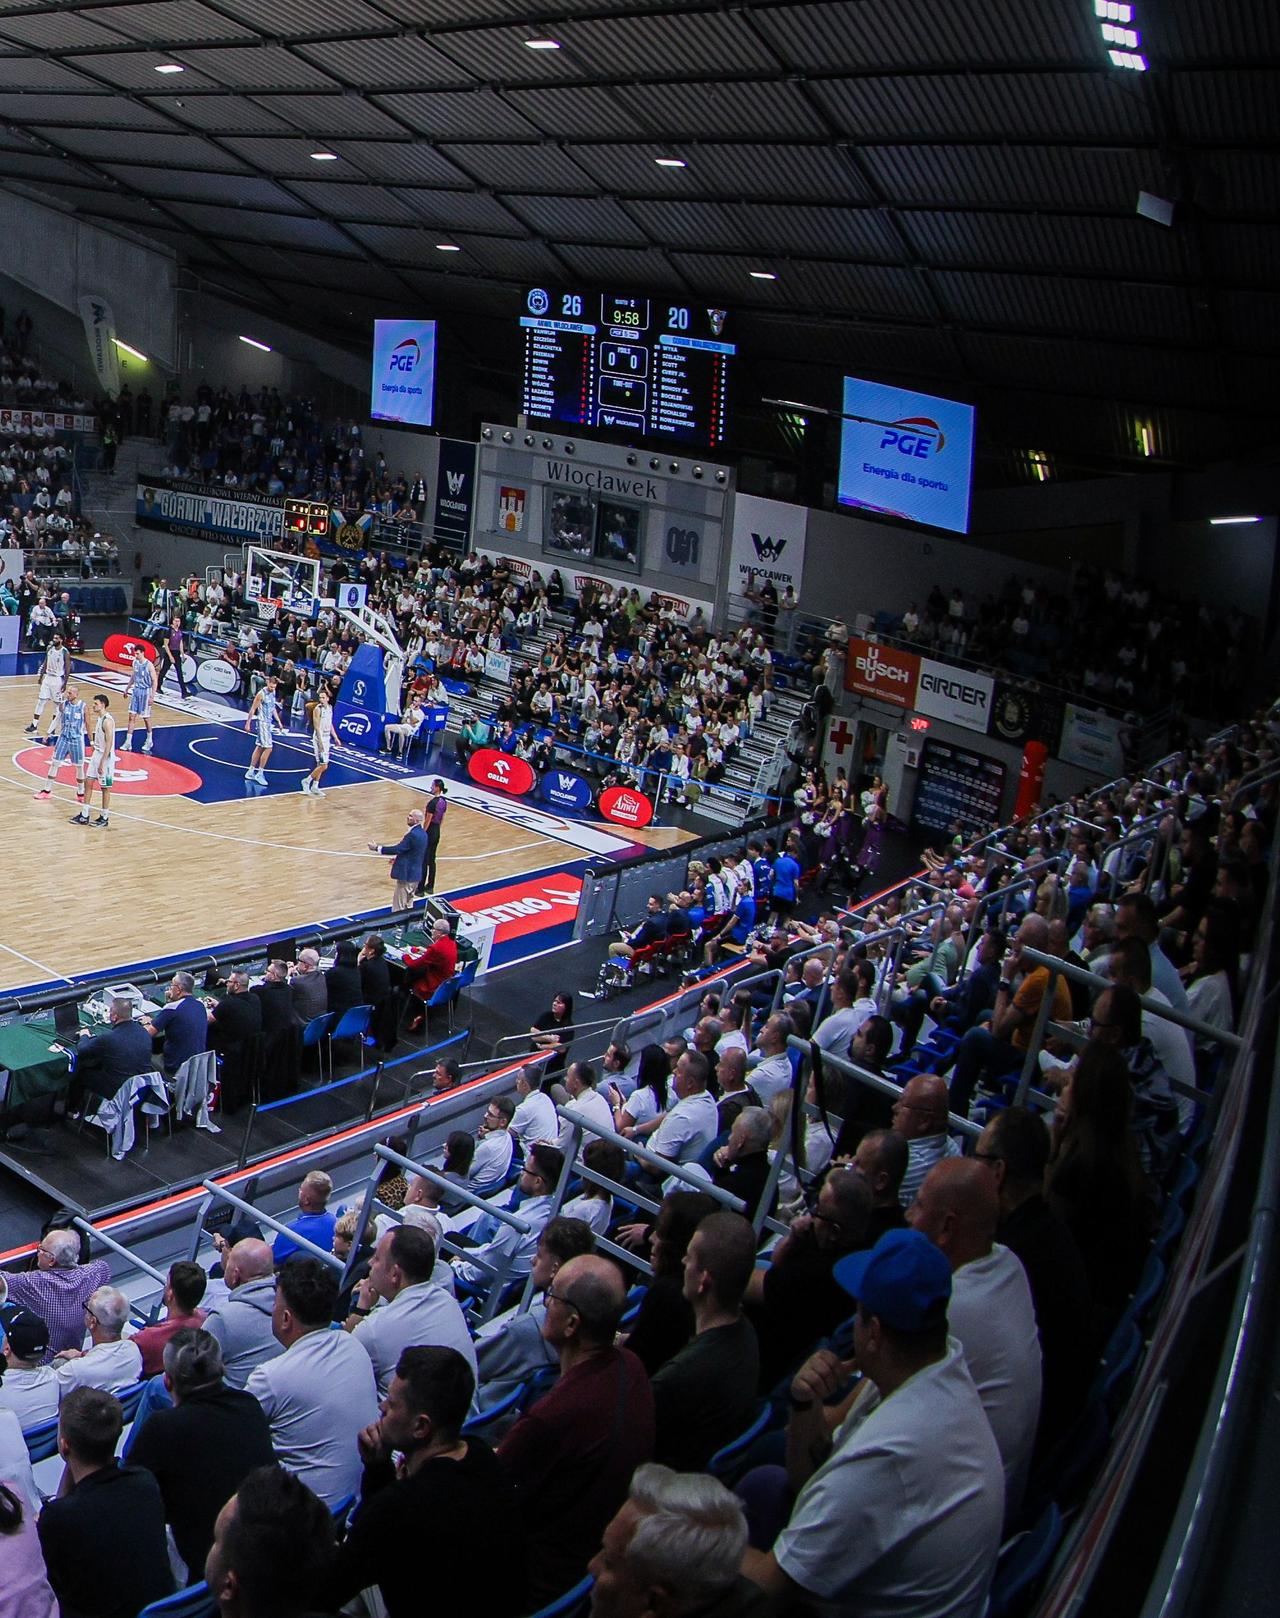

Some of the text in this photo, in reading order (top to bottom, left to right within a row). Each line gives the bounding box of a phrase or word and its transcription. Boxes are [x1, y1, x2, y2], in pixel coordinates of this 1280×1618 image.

[562, 294, 581, 316] 26
[613, 310, 639, 325] 9:58
[668, 307, 688, 329] 20
[389, 355, 414, 371] PGE
[608, 352, 637, 369] 0 0
[880, 430, 934, 459] PGE
[546, 460, 657, 500] Włocławek
[862, 462, 949, 491] Energia dla sportu
[160, 492, 206, 523] GÓRNIK
[739, 564, 793, 583] WŁOCŁAWEK
[856, 656, 909, 684] BUSCH
[921, 673, 987, 709] GIRDER
[339, 718, 366, 736] PGE
[487, 771, 509, 785] ORLEN
[451, 796, 545, 826] PGE
[612, 797, 640, 814] Anwil
